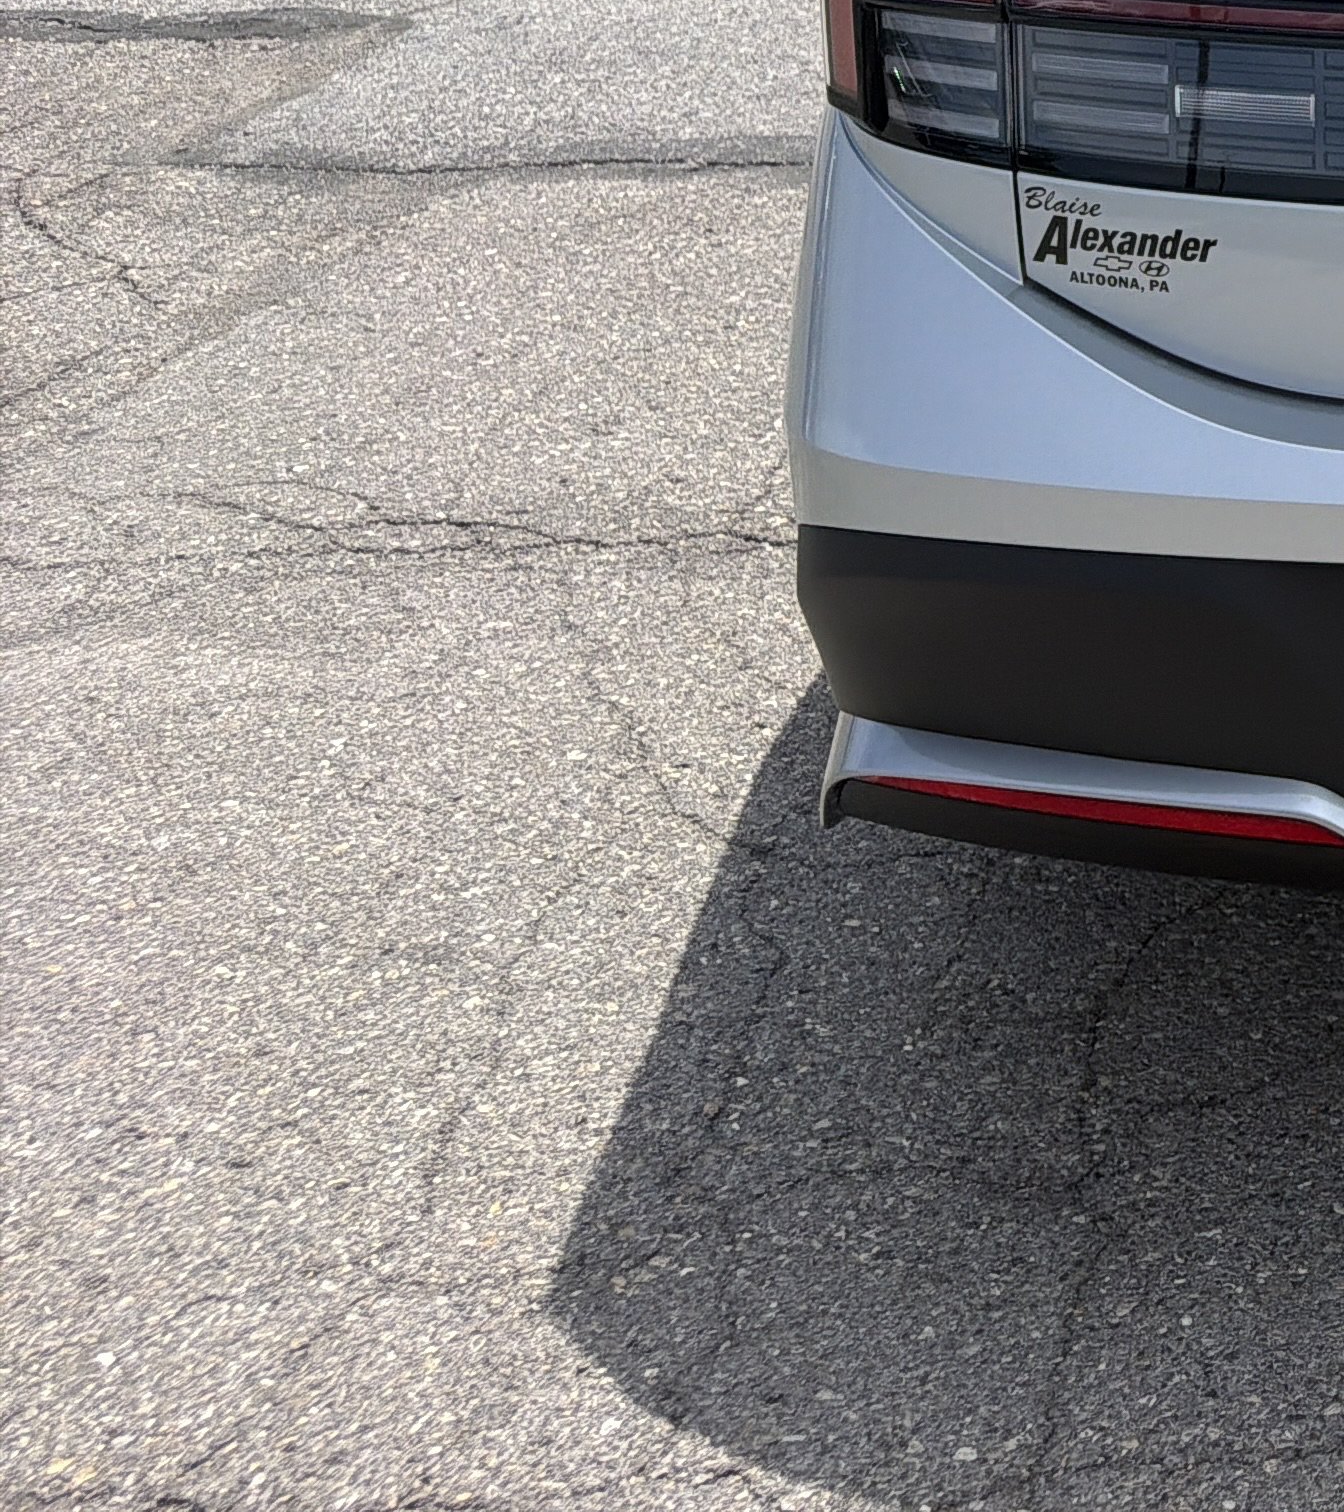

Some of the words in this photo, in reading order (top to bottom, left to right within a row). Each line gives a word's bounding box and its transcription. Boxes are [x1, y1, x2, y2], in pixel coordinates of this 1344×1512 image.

[1024, 186, 1103, 217] Blaise
[1032, 215, 1218, 266] Alexander
[1069, 270, 1145, 294] ALTOONA,
[1149, 279, 1170, 294] PA
